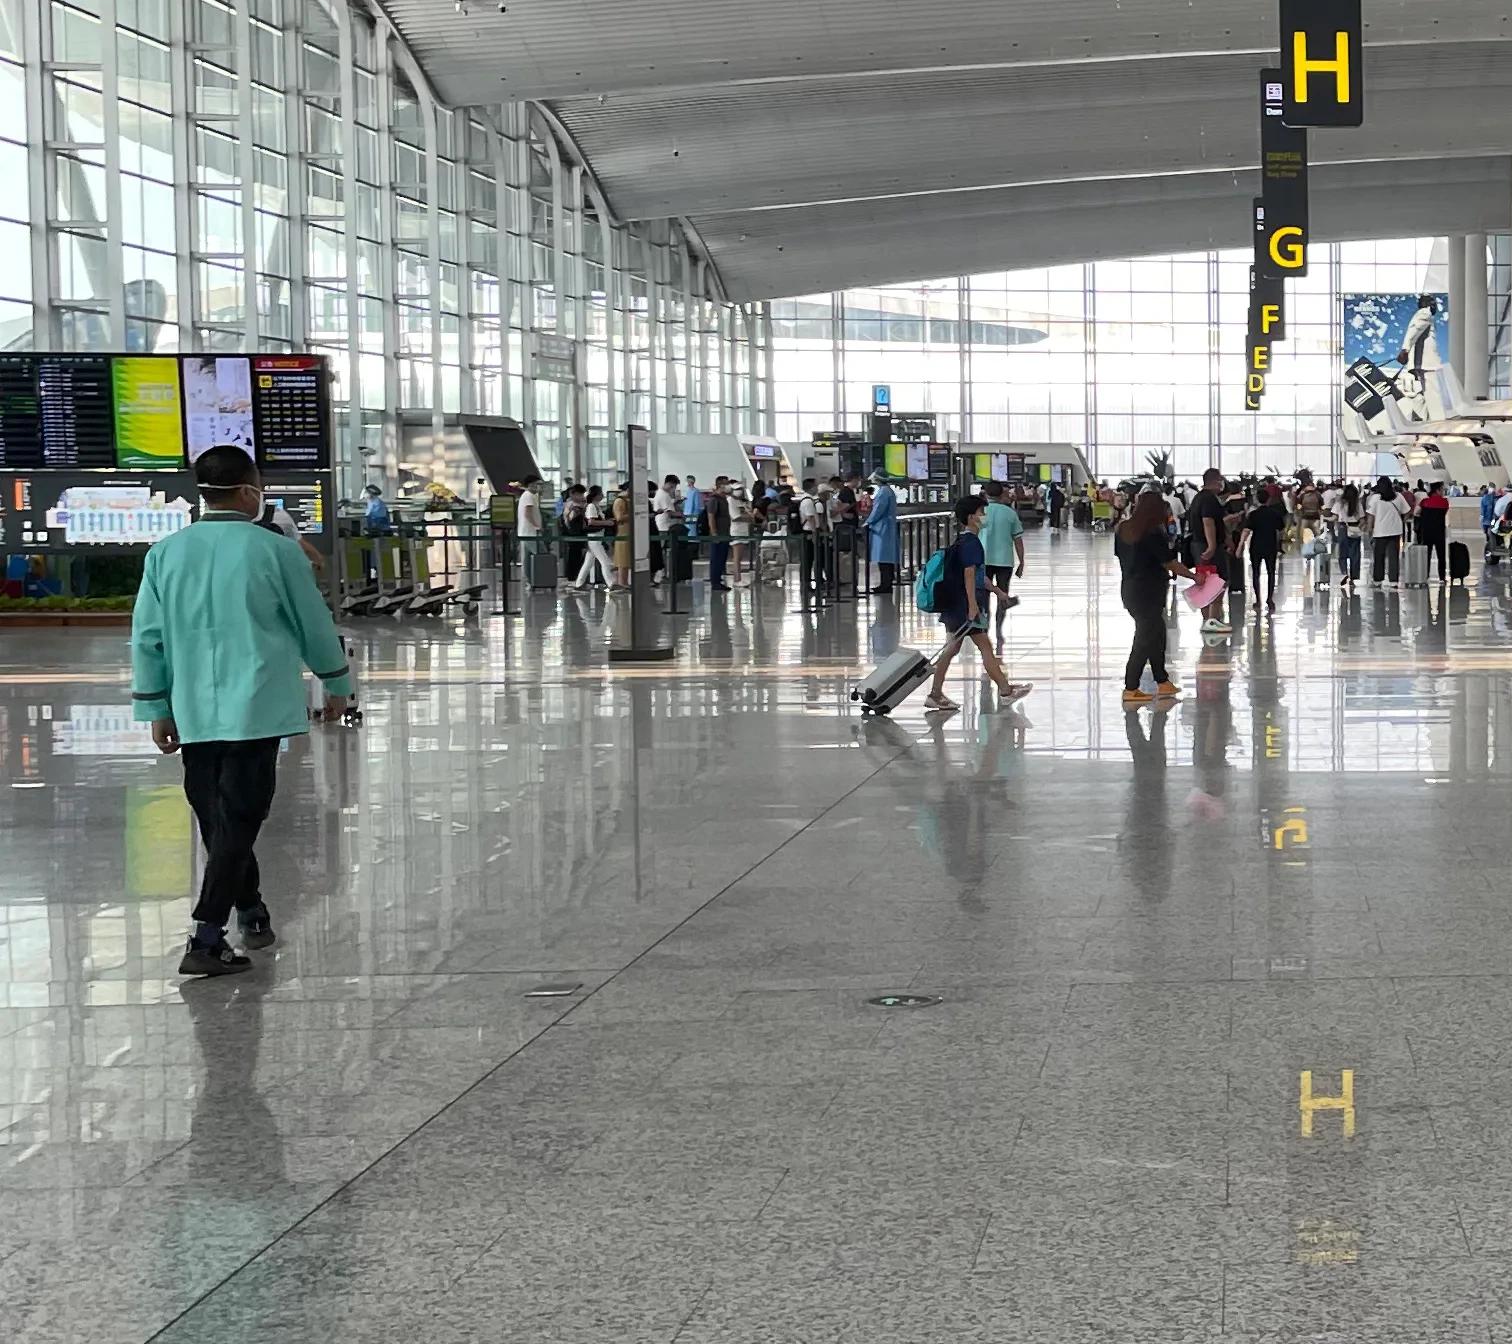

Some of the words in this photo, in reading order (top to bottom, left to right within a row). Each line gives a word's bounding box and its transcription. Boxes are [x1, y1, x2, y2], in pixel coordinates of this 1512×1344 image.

[1294, 32, 1349, 103] H
[1269, 226, 1304, 268] G
[1262, 304, 1280, 334] F
[1254, 346, 1268, 369] E
[1248, 373, 1264, 392] D
